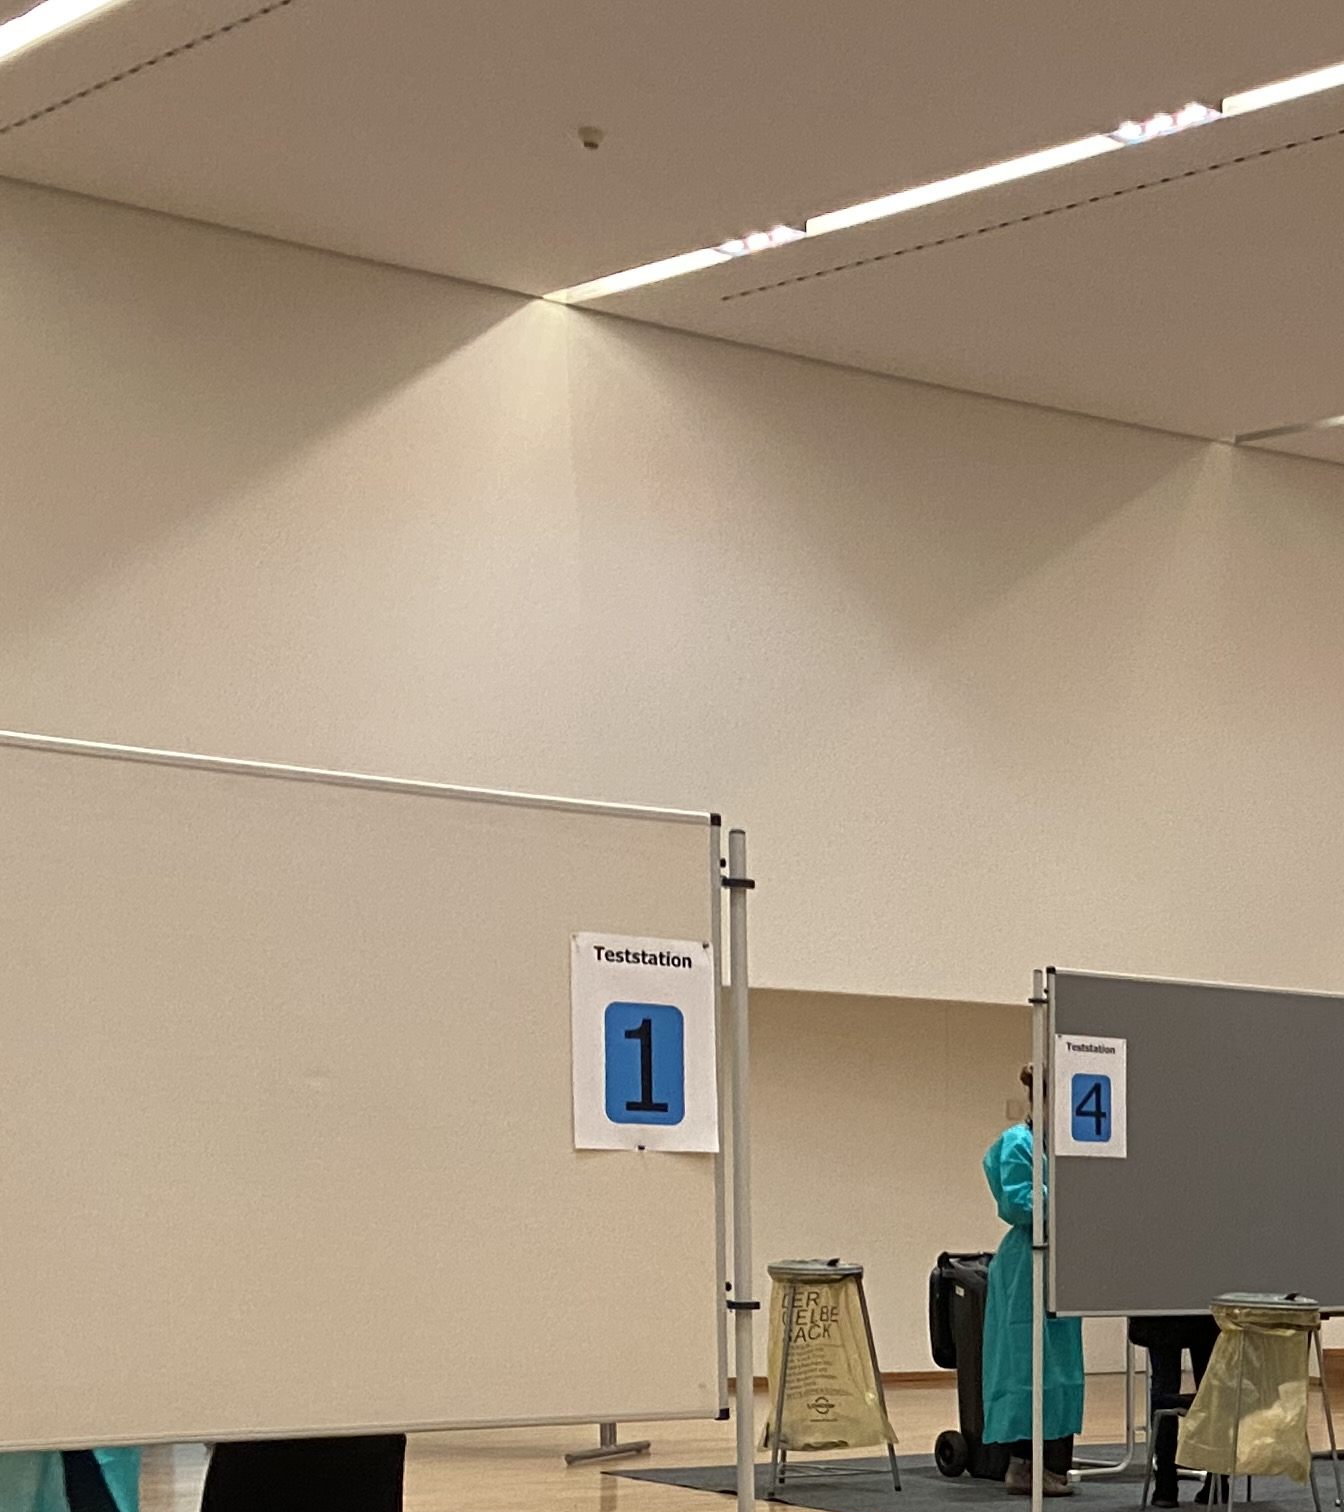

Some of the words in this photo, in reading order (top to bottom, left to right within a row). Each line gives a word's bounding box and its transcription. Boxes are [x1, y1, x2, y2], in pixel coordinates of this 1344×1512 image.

[593, 945, 693, 969] Teststation
[1066, 1041, 1116, 1055] Teststation
[624, 1018, 669, 1113] 1
[1075, 1082, 1107, 1136] 4
[788, 1323, 832, 1344] ACK
